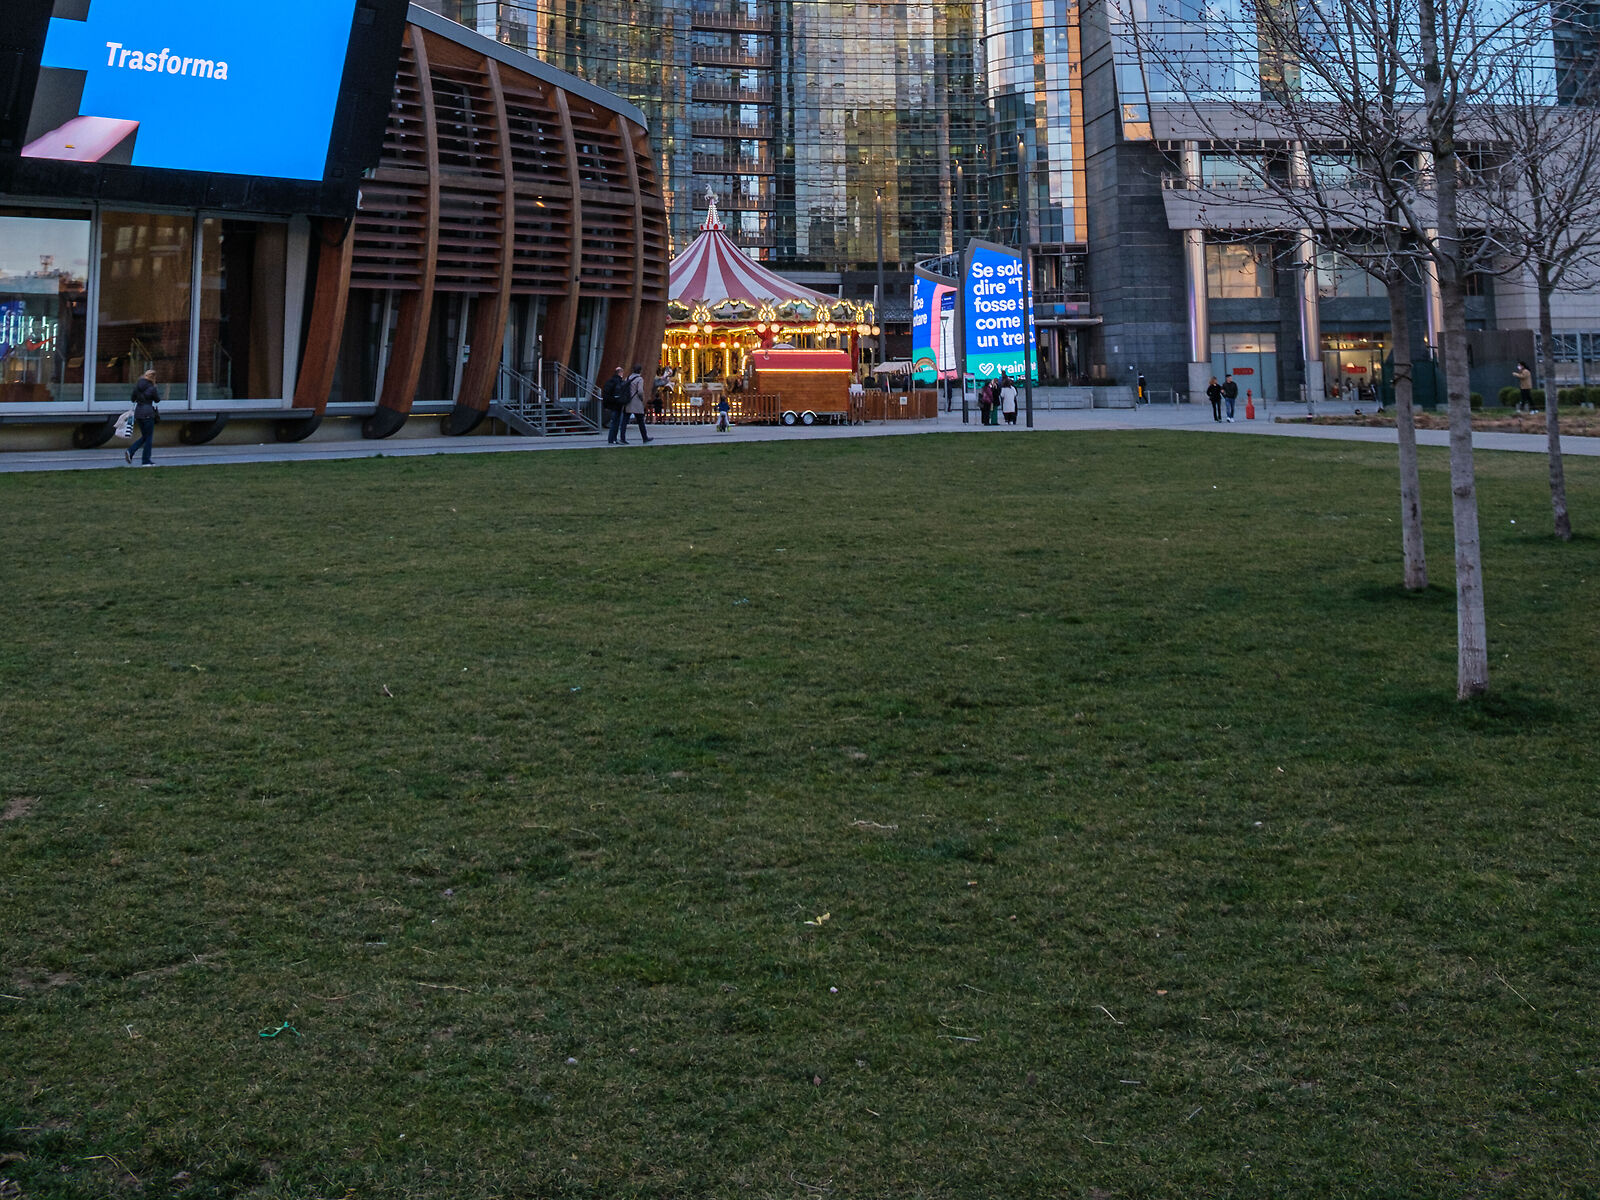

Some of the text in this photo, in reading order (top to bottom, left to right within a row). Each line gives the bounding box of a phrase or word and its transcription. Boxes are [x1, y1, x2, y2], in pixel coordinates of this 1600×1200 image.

[106, 41, 228, 81] Trasforma
[972, 262, 994, 279] Se
[973, 279, 1006, 296] dire
[973, 296, 1016, 313] fosse
[975, 315, 1021, 330] come
[976, 335, 999, 348] un
